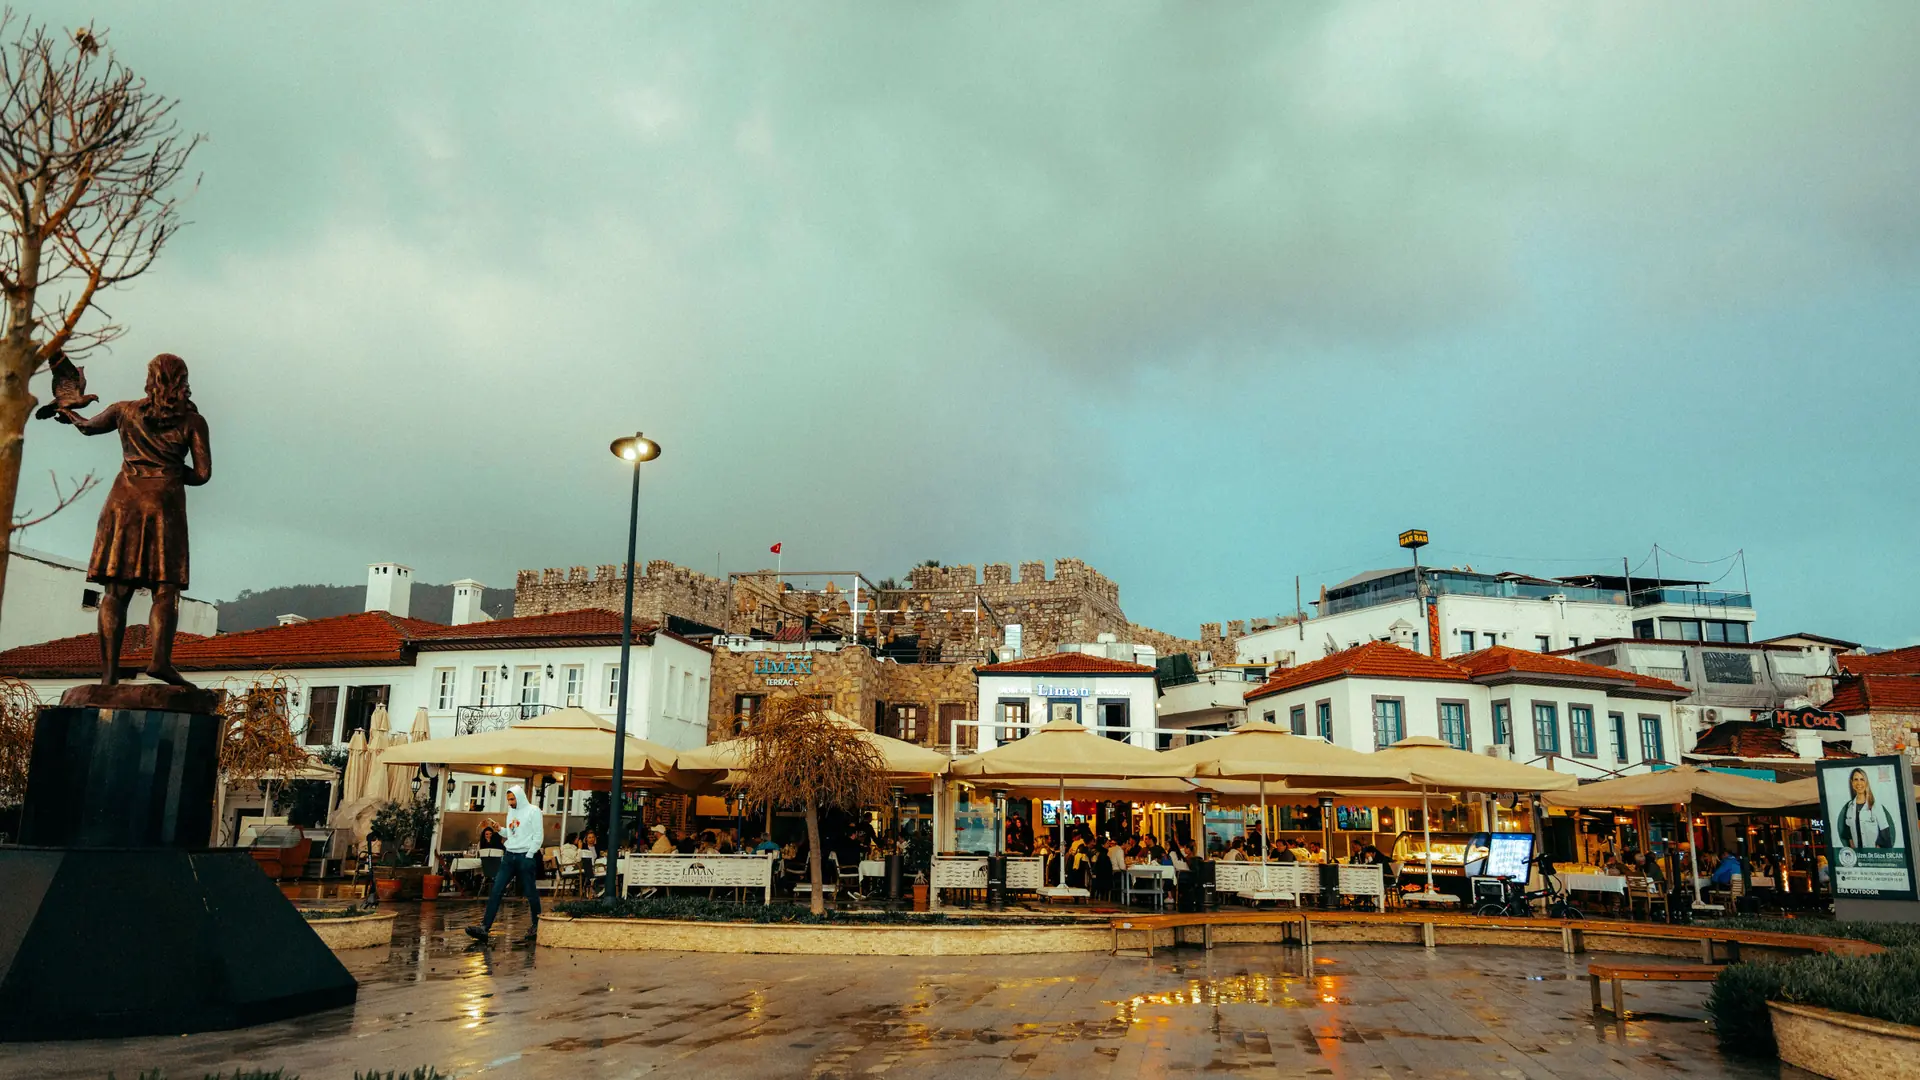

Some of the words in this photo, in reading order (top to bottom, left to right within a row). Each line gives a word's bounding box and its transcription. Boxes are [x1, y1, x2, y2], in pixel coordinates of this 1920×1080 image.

[1414, 535, 1428, 543] BAR
[1037, 684, 1090, 698] Liman
[1776, 710, 1800, 728] Mr.
[1802, 712, 1843, 729] Cook
